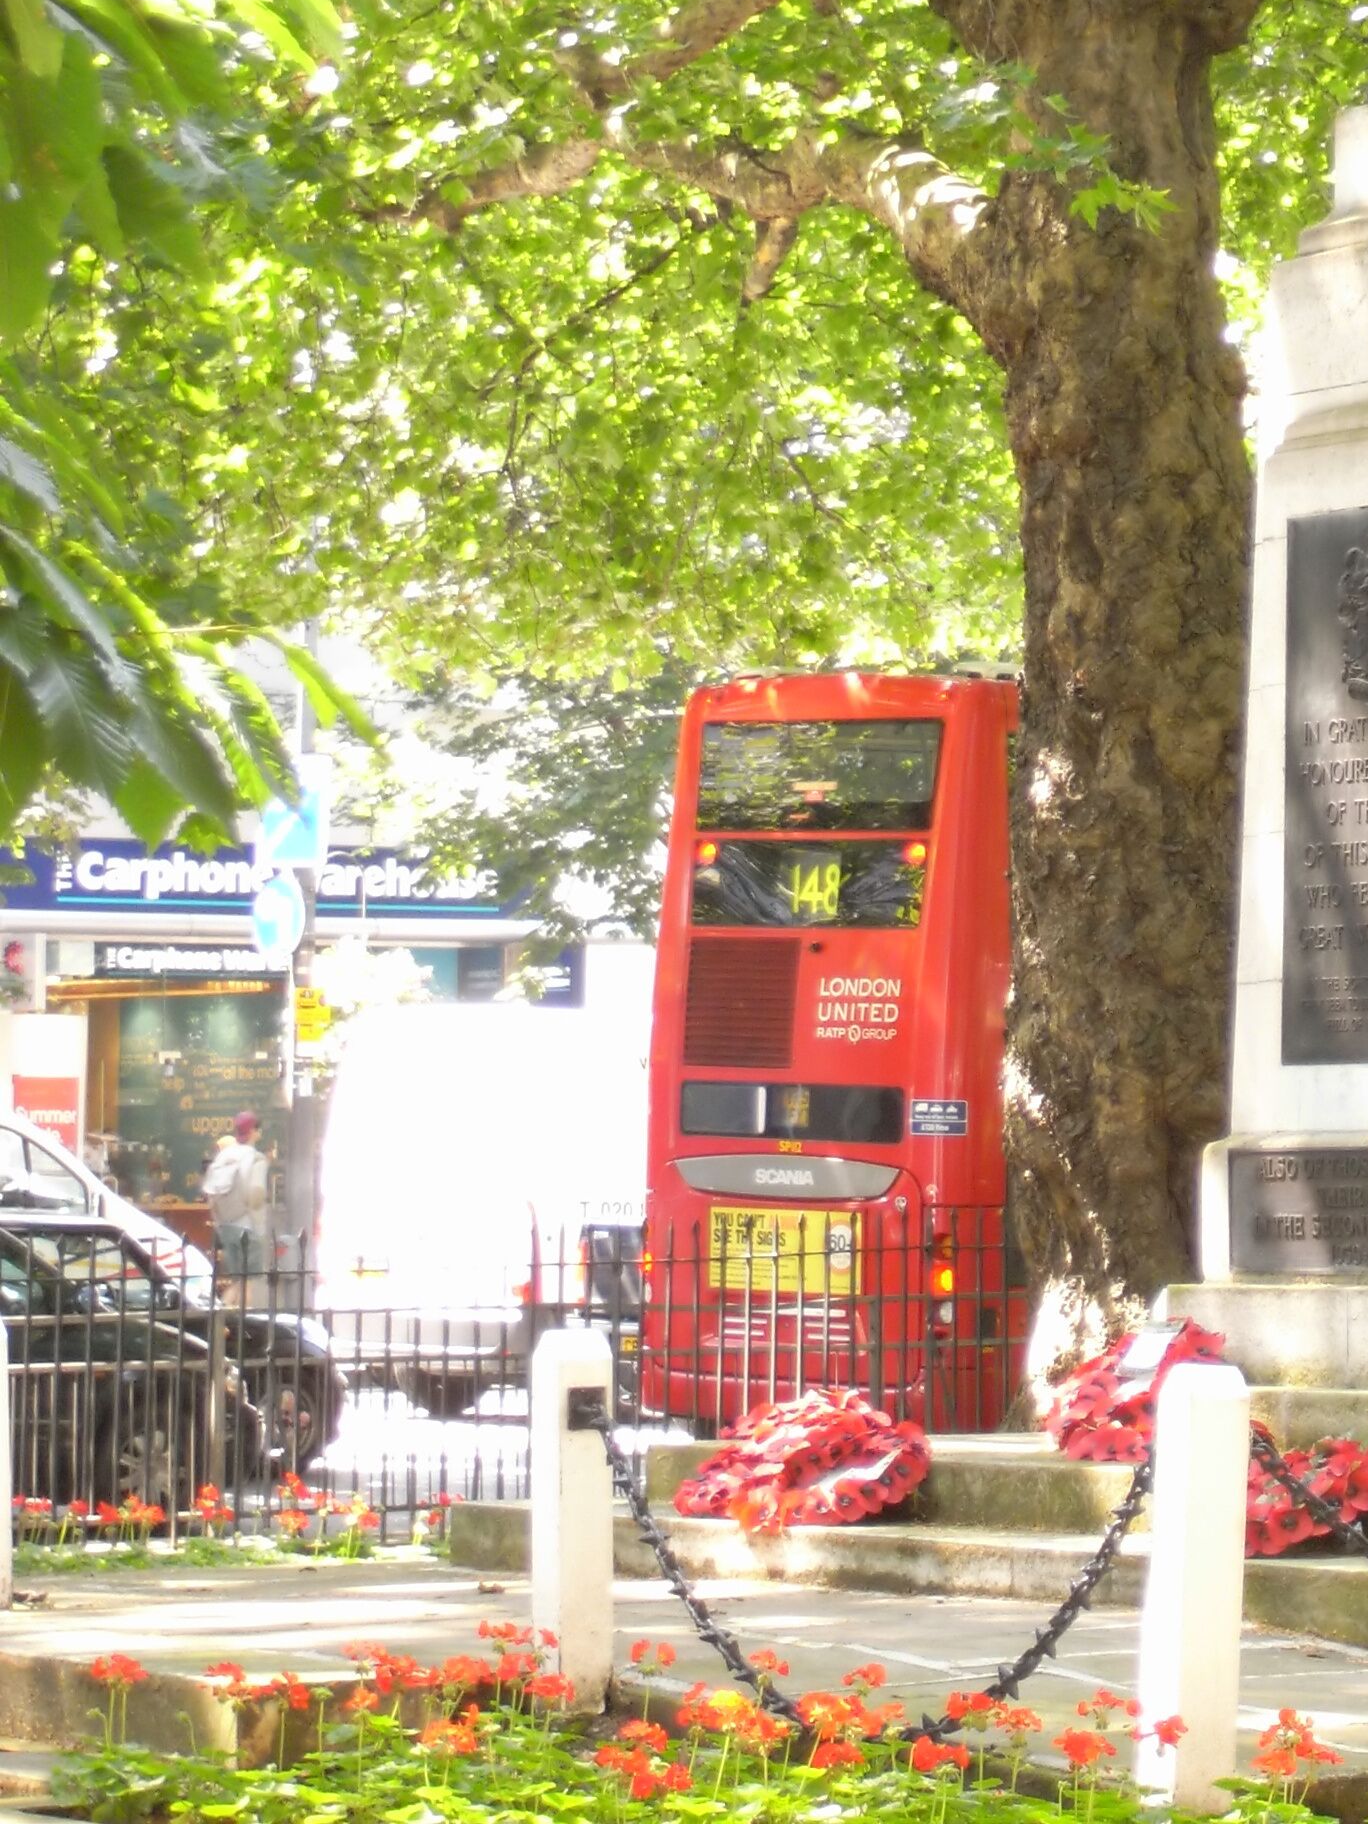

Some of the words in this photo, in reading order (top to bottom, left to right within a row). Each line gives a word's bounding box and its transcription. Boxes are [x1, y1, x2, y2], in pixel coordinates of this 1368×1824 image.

[1304, 721, 1321, 746] IN
[1327, 800, 1347, 826] OF
[1304, 841, 1326, 867] OF
[1331, 839, 1368, 867] THIS
[791, 863, 841, 916] 148
[1304, 882, 1343, 909] WHO
[819, 977, 901, 997] LONDON
[817, 1003, 899, 1023] UNITED
[816, 1026, 846, 1039] RATP
[861, 1028, 898, 1041] GROUP
[755, 1169, 814, 1186] SCANIA
[1259, 1154, 1299, 1182] ALSO
[713, 1211, 734, 1227] YOU
[1273, 1213, 1305, 1241] THE
[757, 1230, 786, 1247] SIGS
